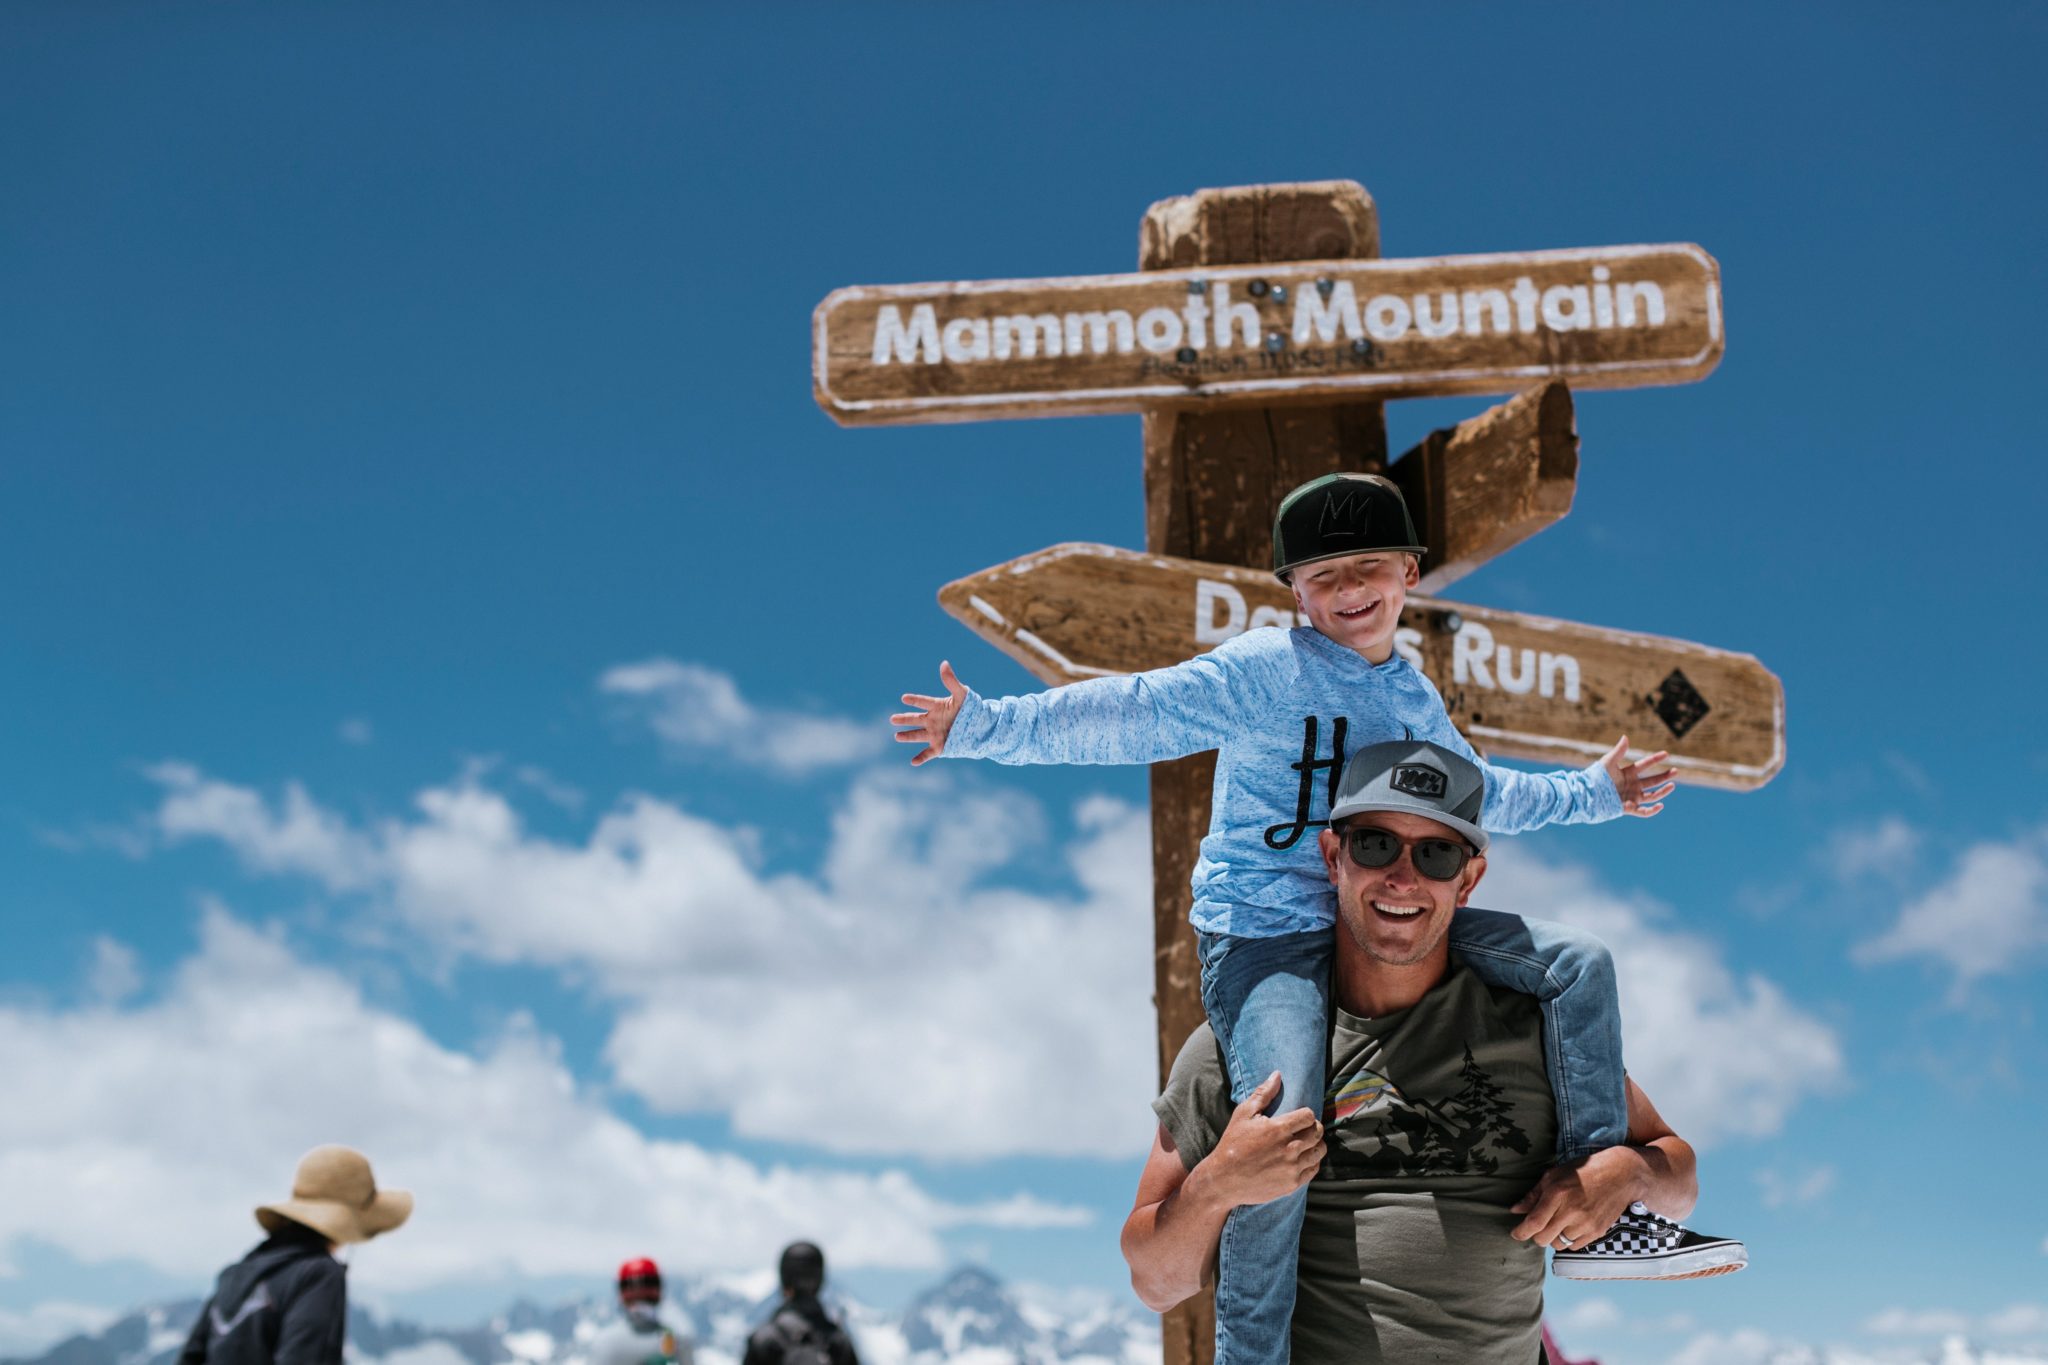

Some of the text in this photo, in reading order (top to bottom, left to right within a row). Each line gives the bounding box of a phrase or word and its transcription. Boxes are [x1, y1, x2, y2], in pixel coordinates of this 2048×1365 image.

[872, 265, 1667, 365] Mammoth Mountain
[1453, 621, 1580, 703] Run
[1397, 768, 1442, 792] 100%
